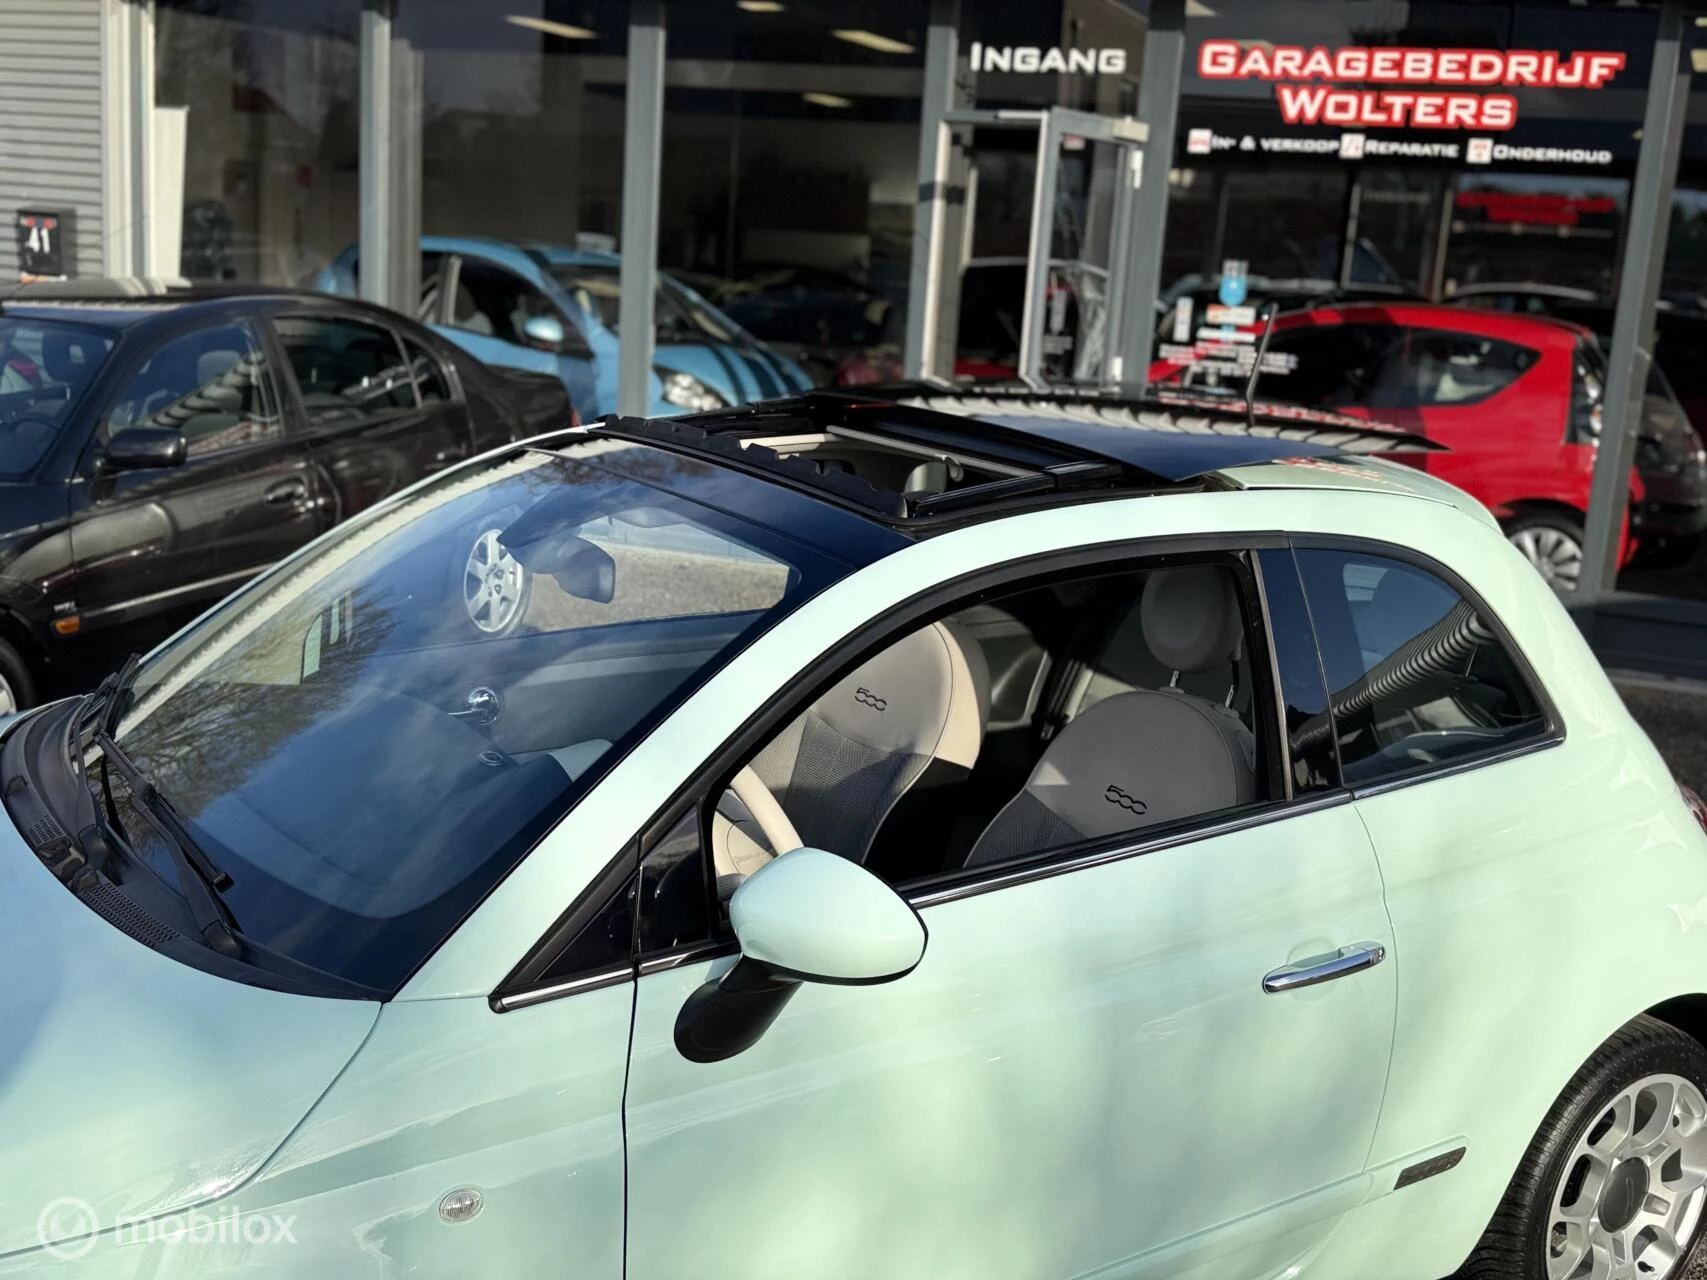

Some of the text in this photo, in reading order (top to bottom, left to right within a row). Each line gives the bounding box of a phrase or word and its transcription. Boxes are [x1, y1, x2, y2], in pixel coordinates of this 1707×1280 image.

[970, 41, 1127, 74] INGANG
[1199, 41, 1624, 87] GARAGEBEDRIJF
[1278, 85, 1516, 128] WOLTERS
[1239, 135, 1256, 151] &
[1260, 137, 1340, 153] VERKOOP
[1364, 139, 1459, 158] REPARATIE
[1492, 144, 1613, 164] ONDERHOUD
[25, 226, 50, 254] 41
[854, 686, 888, 711] 500
[1104, 784, 1148, 815] 500
